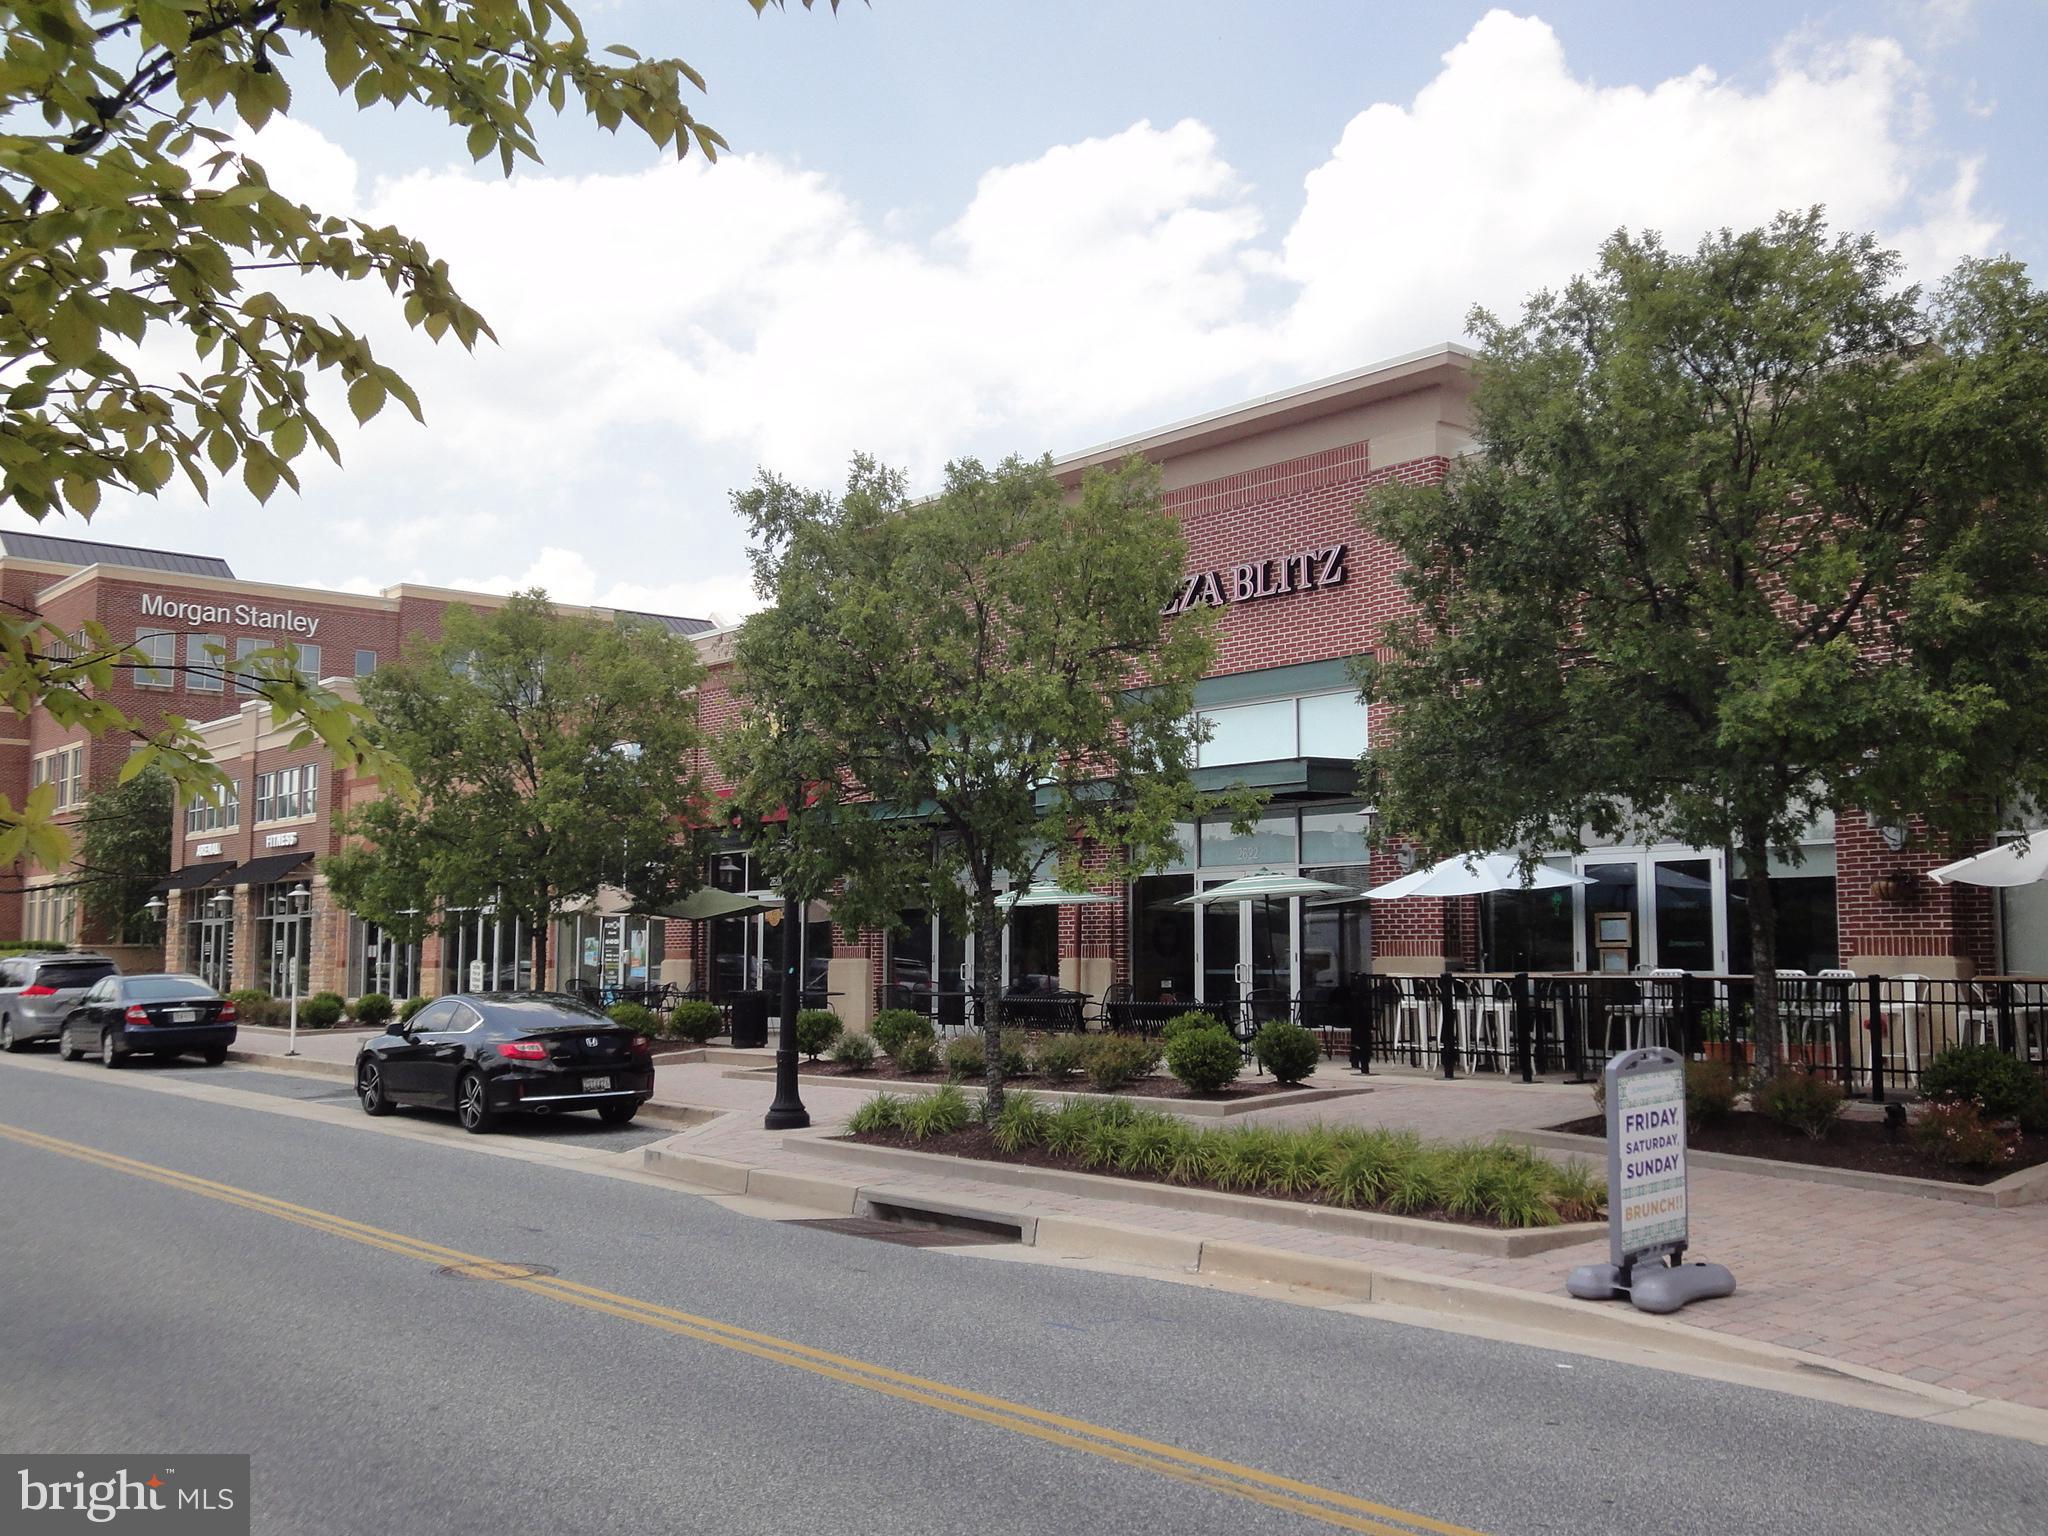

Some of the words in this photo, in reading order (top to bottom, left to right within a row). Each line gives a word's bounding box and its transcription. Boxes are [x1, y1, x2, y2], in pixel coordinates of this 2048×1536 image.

[1231, 545, 1344, 602] BLITZ
[141, 593, 230, 625] Morgan
[235, 605, 319, 637] Stanley
[1626, 1107, 1679, 1133] FRIDAY,
[1626, 1134, 1680, 1154] SATURDAY,
[1627, 1154, 1679, 1178] SUNDAY
